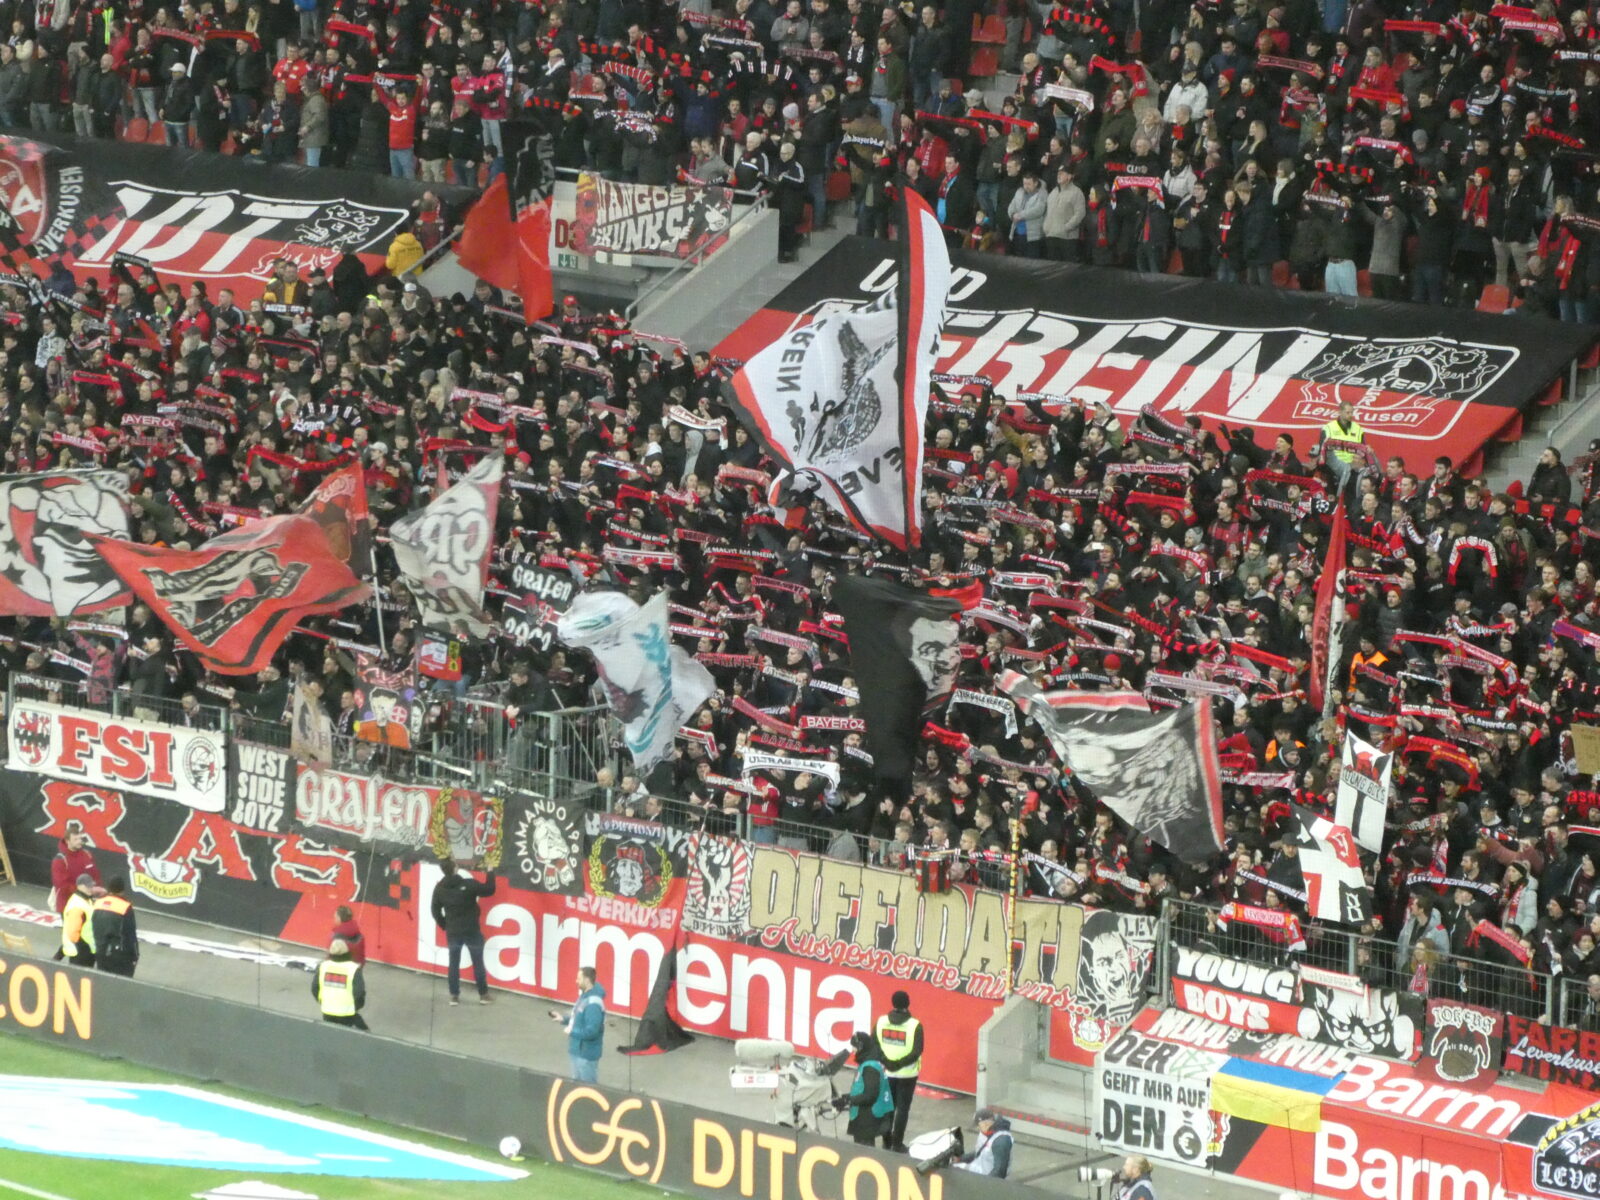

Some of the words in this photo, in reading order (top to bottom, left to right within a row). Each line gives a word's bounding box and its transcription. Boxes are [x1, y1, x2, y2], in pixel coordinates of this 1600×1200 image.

[1349, 376, 1428, 391] BAYER
[1301, 404, 1419, 424] Levekusen
[806, 717, 849, 729] BAYER
[849, 718, 866, 730] 04
[56, 714, 176, 790] FSI
[237, 744, 289, 780] WEST
[748, 756, 792, 766] ULTRAS
[801, 760, 826, 769] LEV
[237, 772, 286, 808] SIDE
[230, 800, 284, 833] BOYZ
[137, 874, 190, 897] Leverkusen
[750, 847, 1086, 994] DIFFIDATI
[417, 861, 873, 1055] Barmenia
[761, 916, 960, 991] Ausgesperrte
[1177, 947, 1295, 1003] YOUNG
[0, 960, 91, 1040] ON
[1183, 983, 1270, 1031] BOYS
[1104, 1032, 1181, 1075] DER
[1103, 1070, 1140, 1096] GEHT
[1143, 1078, 1173, 1103] MIR
[1177, 1085, 1206, 1110] AUF
[1326, 1054, 1526, 1136] Barm
[1103, 1098, 1166, 1151] DEN
[1313, 1119, 1503, 1200] Barm
